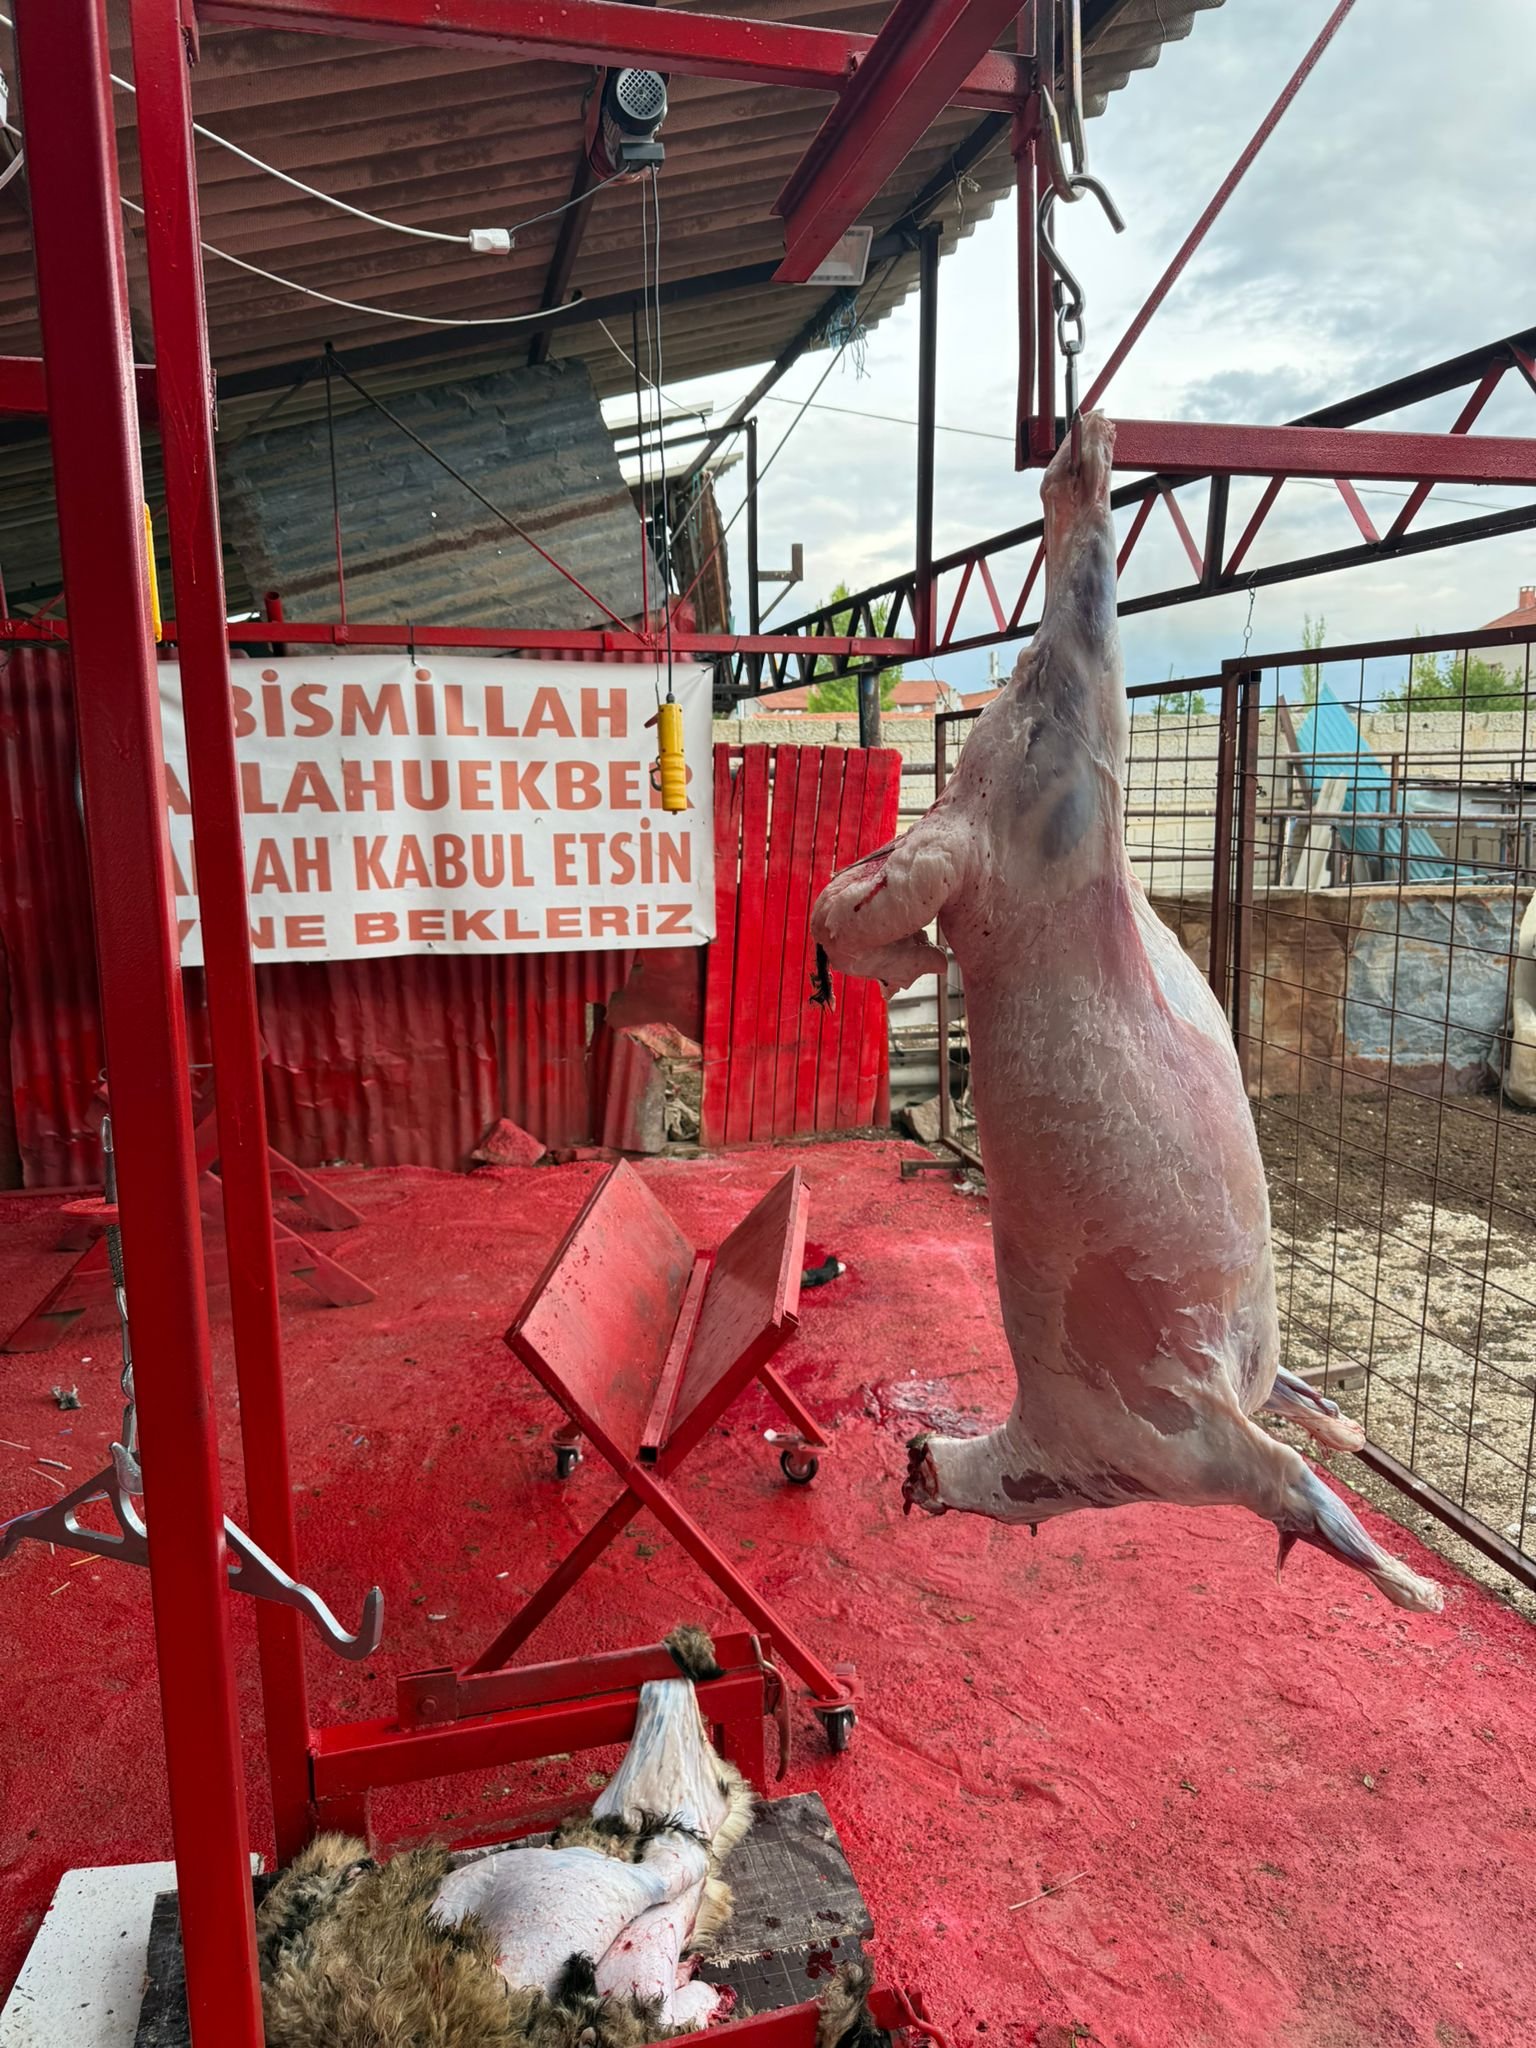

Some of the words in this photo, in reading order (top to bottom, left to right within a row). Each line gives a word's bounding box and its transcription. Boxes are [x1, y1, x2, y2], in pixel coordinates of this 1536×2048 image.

[165, 758, 695, 815] LAHUEKBE
[353, 833, 535, 891] KABUL
[553, 817, 692, 886] ETSİN
